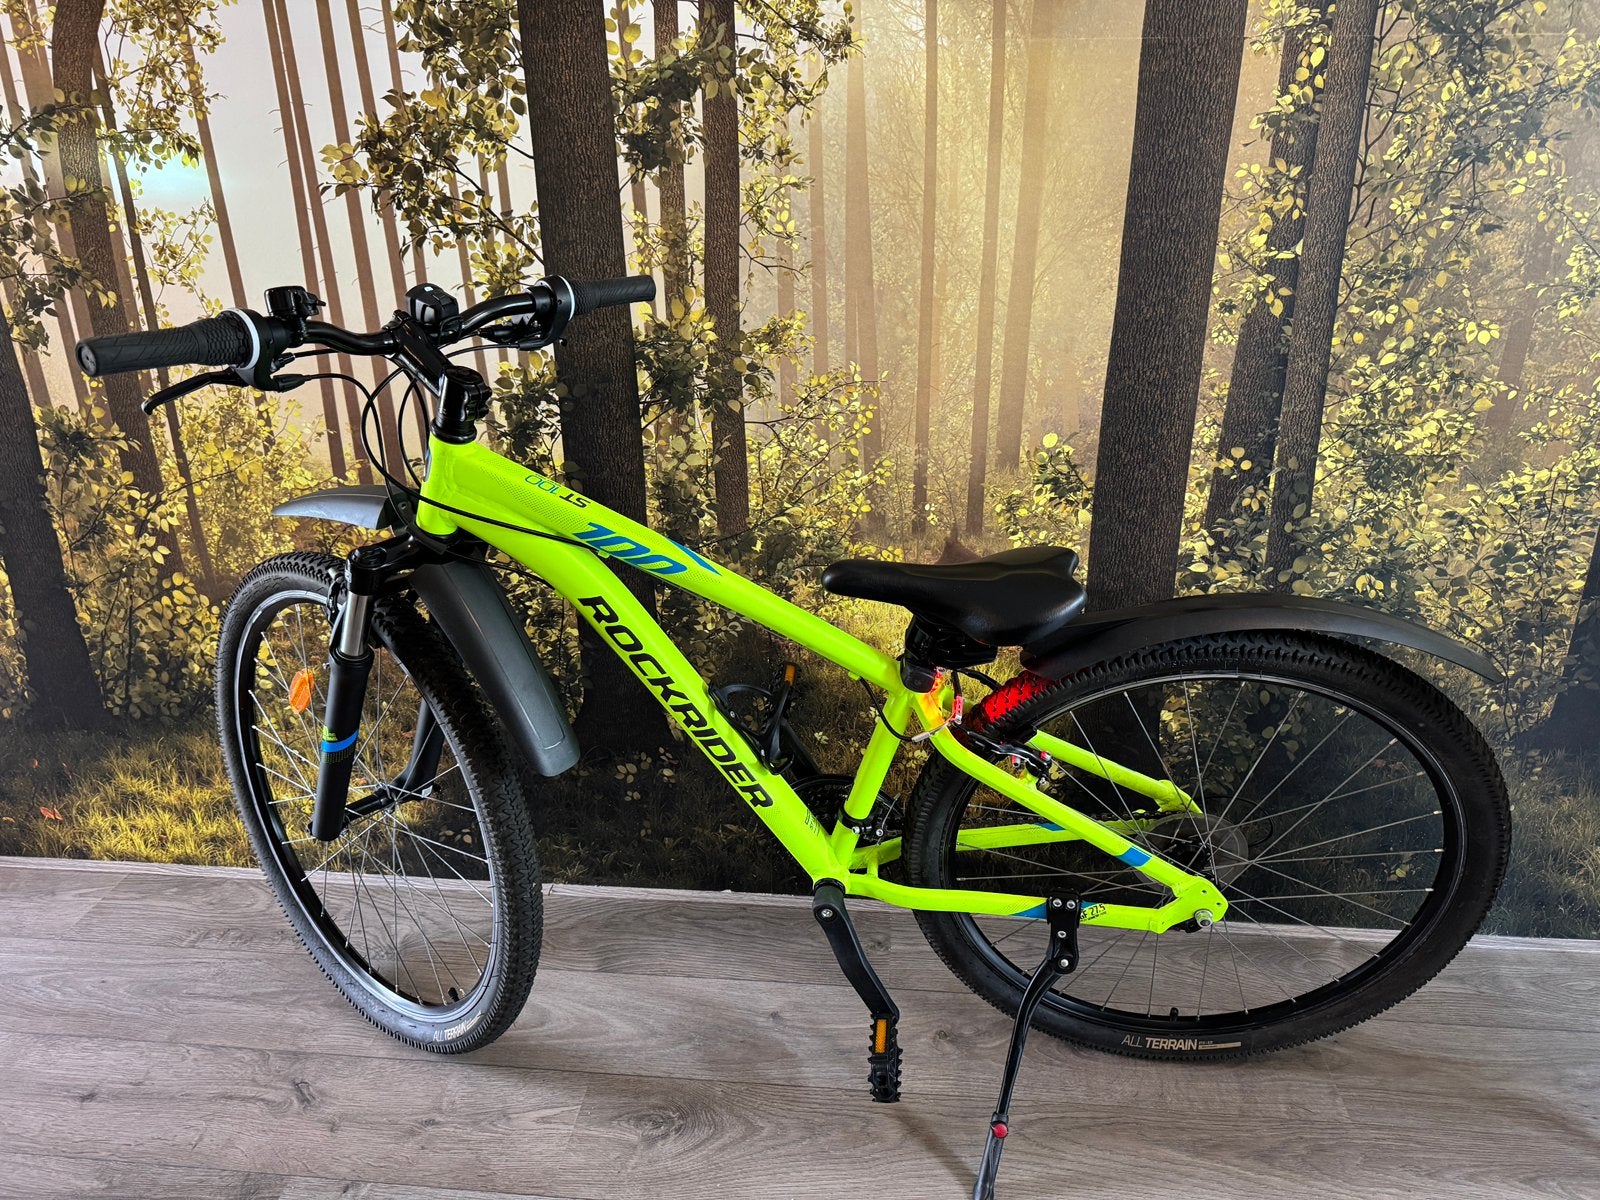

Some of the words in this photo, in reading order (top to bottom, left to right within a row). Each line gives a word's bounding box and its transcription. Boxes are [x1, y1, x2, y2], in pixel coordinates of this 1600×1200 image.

[525, 475, 559, 494] 100
[559, 493, 591, 508] ST
[572, 522, 688, 575] 100
[578, 596, 774, 808] ROCKRIDER
[1121, 1034, 1143, 1048] ALL
[1145, 1037, 1198, 1051] TERRAIN
